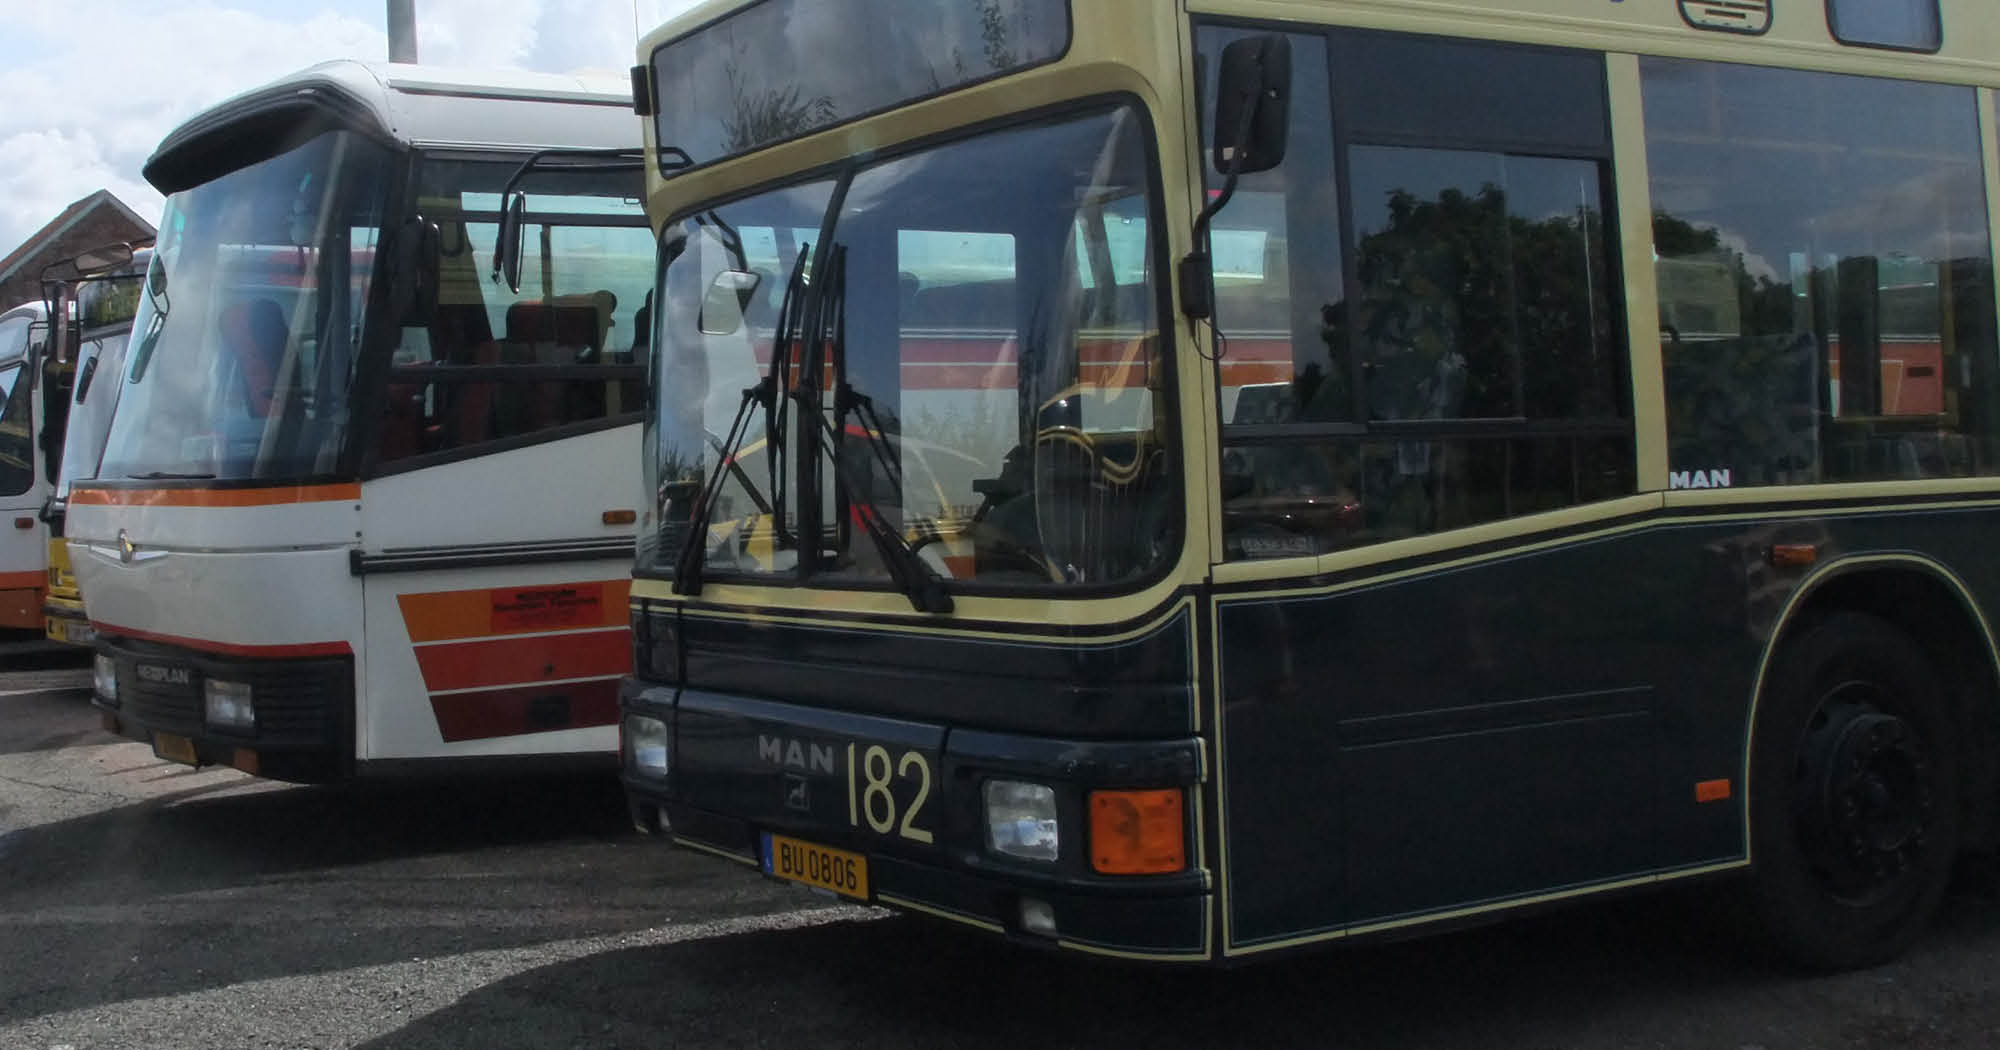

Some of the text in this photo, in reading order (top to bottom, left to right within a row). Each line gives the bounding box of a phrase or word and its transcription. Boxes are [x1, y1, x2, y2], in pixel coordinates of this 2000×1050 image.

[1670, 469, 1730, 489] MAN
[759, 735, 834, 774] MAN
[848, 741, 934, 844] 182
[781, 843, 857, 889] BU 0806
